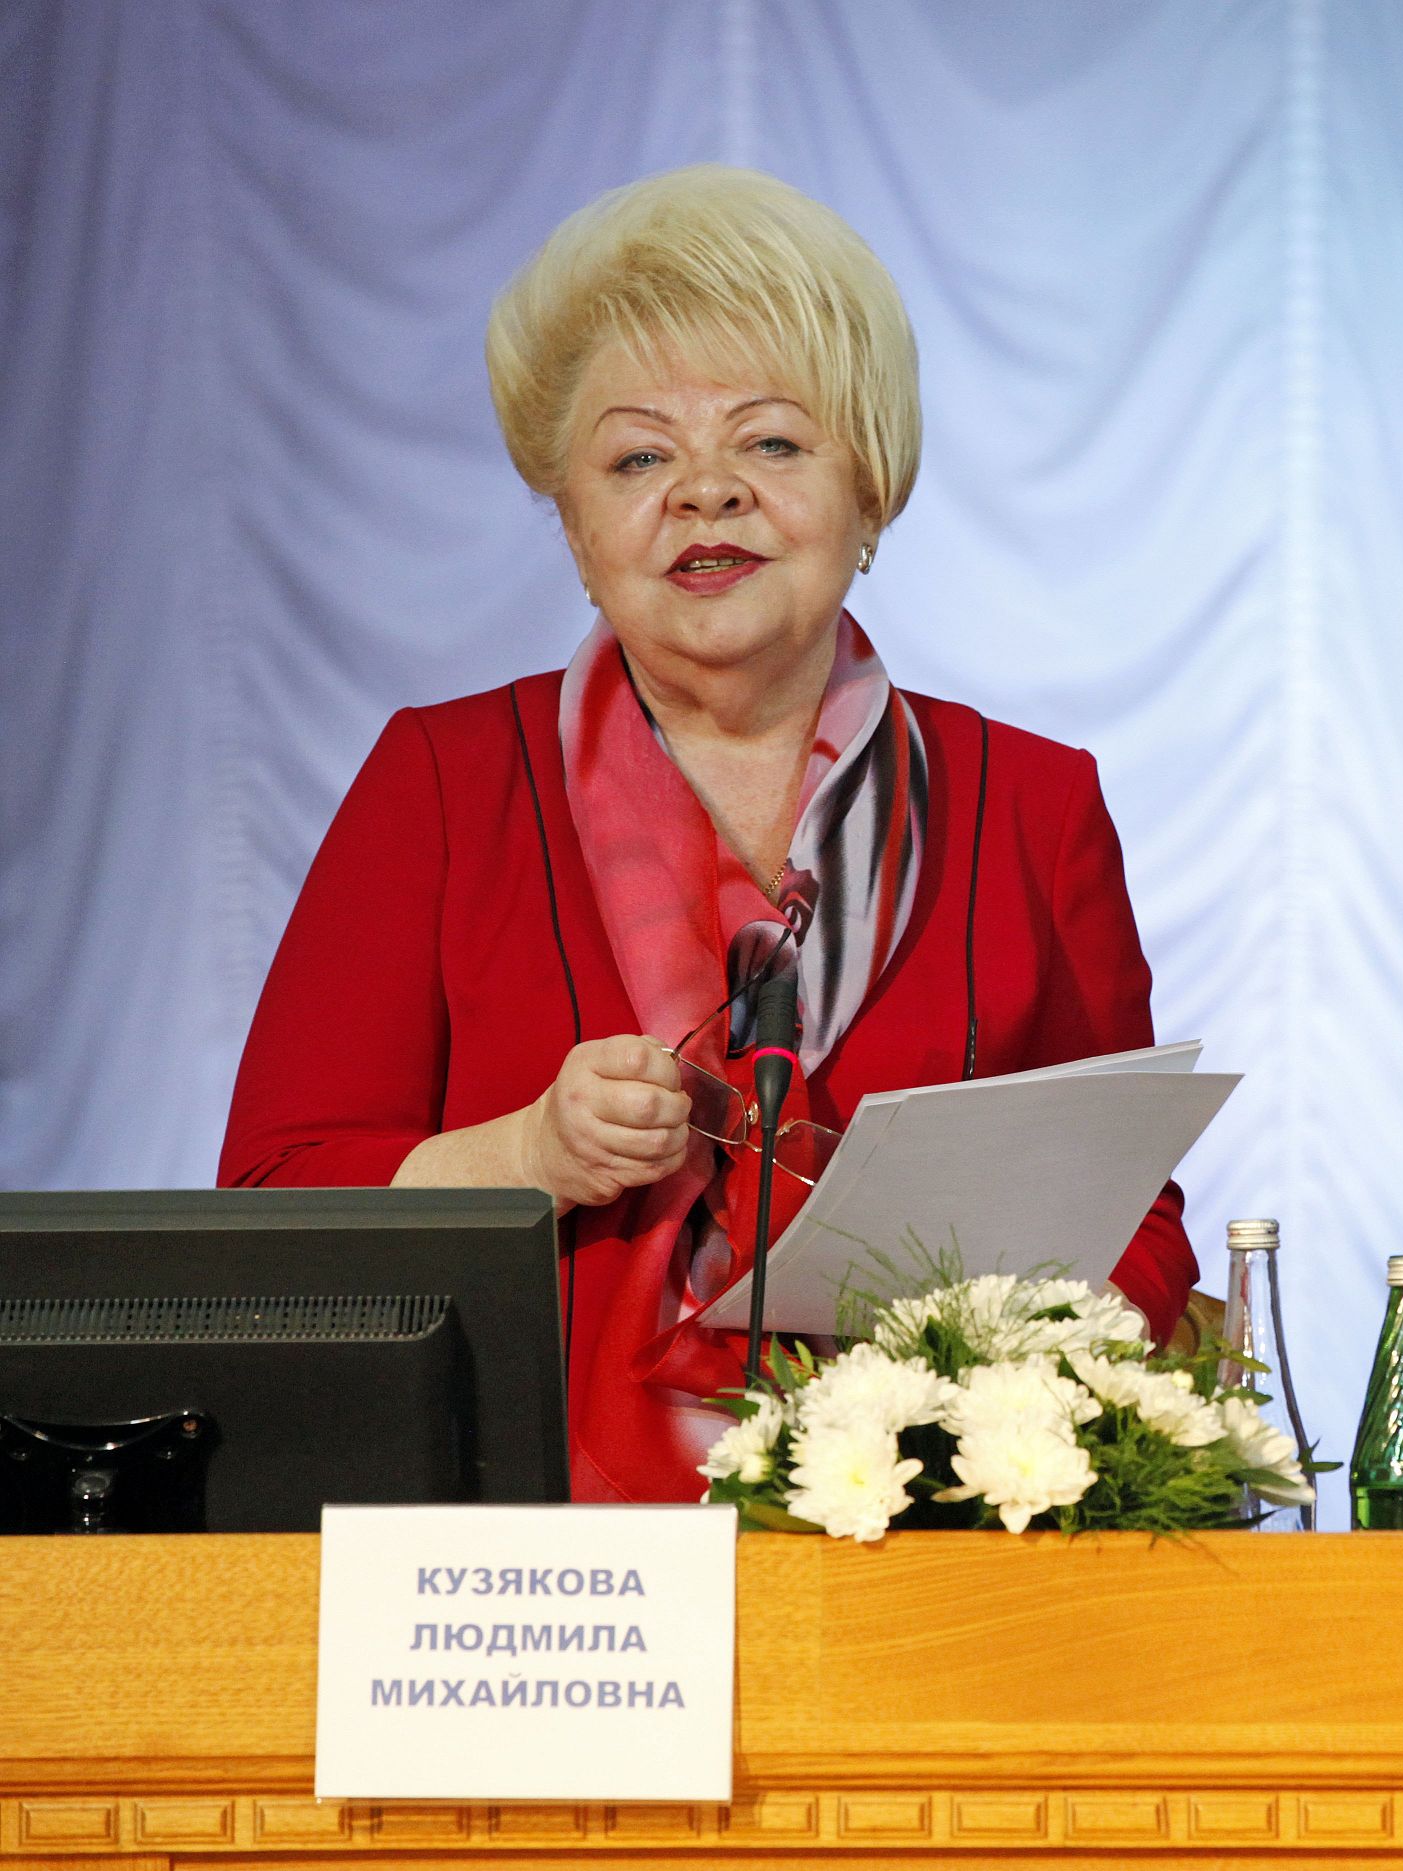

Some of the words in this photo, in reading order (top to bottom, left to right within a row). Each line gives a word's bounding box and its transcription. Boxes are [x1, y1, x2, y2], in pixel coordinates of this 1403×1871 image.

[417, 1567, 645, 1596] КУЗЯКОВА
[410, 1623, 647, 1657] ЛЮДМИЛА
[371, 1673, 686, 1708] МИХАЙЛОВНА
